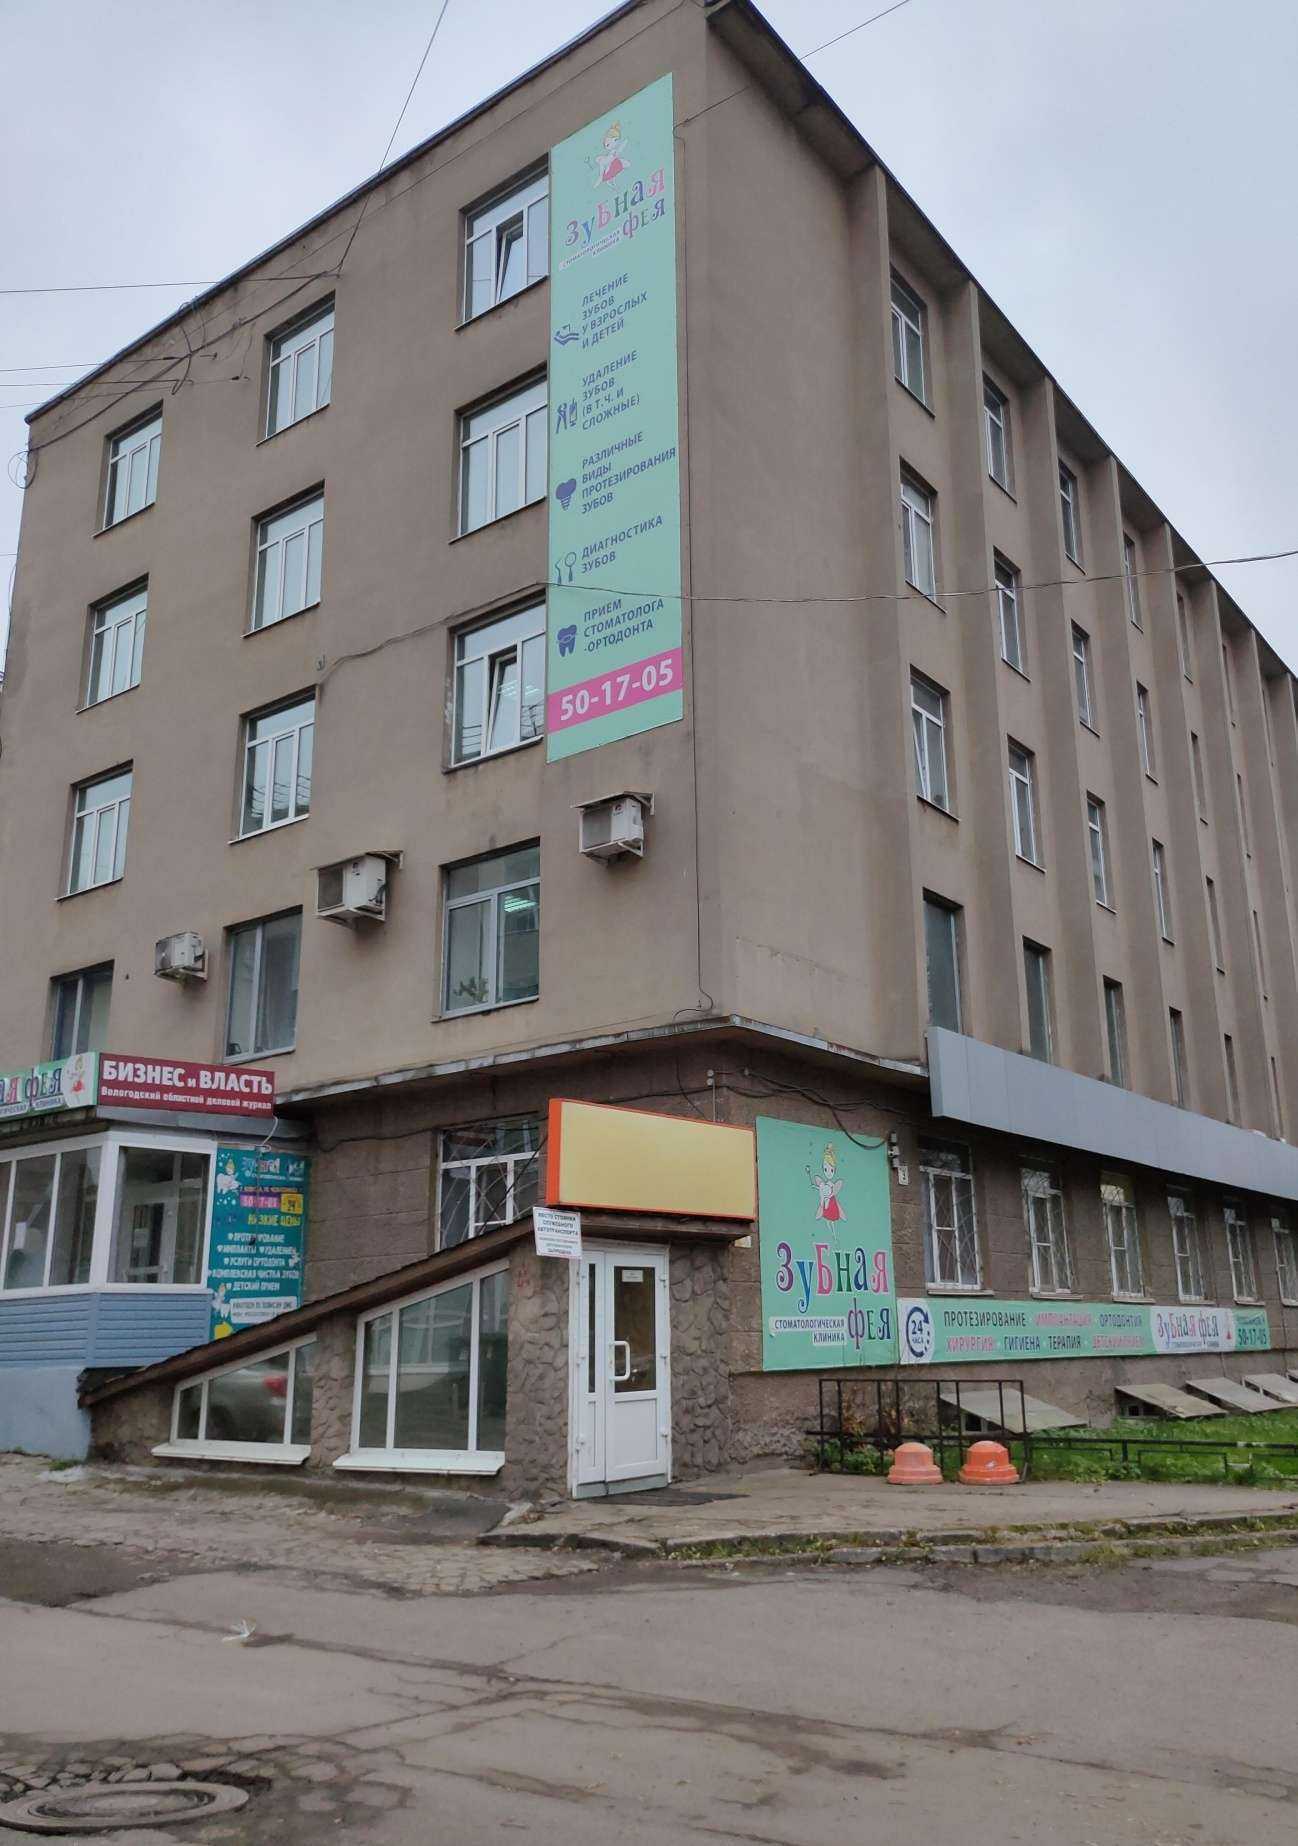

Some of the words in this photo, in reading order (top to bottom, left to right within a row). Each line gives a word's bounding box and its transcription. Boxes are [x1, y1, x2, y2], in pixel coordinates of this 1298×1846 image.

[582, 273, 629, 307] ЛЕЧЕНИЕ
[582, 295, 615, 321] ЗУБОВ
[582, 324, 588, 335] У
[590, 290, 648, 331] ВЗРОСЛЫХ
[582, 338, 589, 349] И
[591, 318, 625, 343] ДЕТЕЙ
[582, 350, 638, 388] УДАЛЕНИЕ
[582, 403, 593, 417] (В
[616, 387, 625, 399] И
[583, 377, 615, 401] ЗУБОВ
[582, 393, 641, 431] СЛОЖНЫЕ)
[582, 432, 643, 469] РАЗЛИЧНЫЕ
[582, 462, 612, 484] ВИДЫ
[582, 447, 676, 500] ПРОТЕЗИРОВАНИЯ
[581, 492, 614, 515] ЗУБОВ
[581, 515, 663, 561] ДИАГНОСТИКА
[581, 551, 616, 574] ЗУБОВ
[583, 598, 664, 637] СТОМАТОЛОГА
[584, 599, 622, 622] ПРИЕМ
[560, 657, 674, 721] 50-17-05
[102, 1059, 186, 1087] БИЗНЕС
[187, 1077, 197, 1089] и
[200, 1070, 273, 1095] ВЛАСТЬ
[101, 1086, 161, 1101] Вологодский
[163, 1092, 204, 1105] областной
[207, 1096, 241, 1108] деловой
[242, 1101, 272, 1111] журнал
[774, 1319, 845, 1329] СТОМАТОЛОГИЧЕСКАЯ
[911, 1320, 924, 1335] 24
[943, 1310, 1027, 1327] ПРОТЕЗИРОВАНИЕ
[1099, 1313, 1142, 1327] ОРТОДОНТИЯ
[813, 1332, 845, 1343] КЛИНИКА
[946, 1336, 994, 1353] ХИРУРГИЯ
[1004, 1336, 1041, 1351] ГИГИЕНА
[1048, 1335, 1081, 1350] ТЕРАПИЯ
